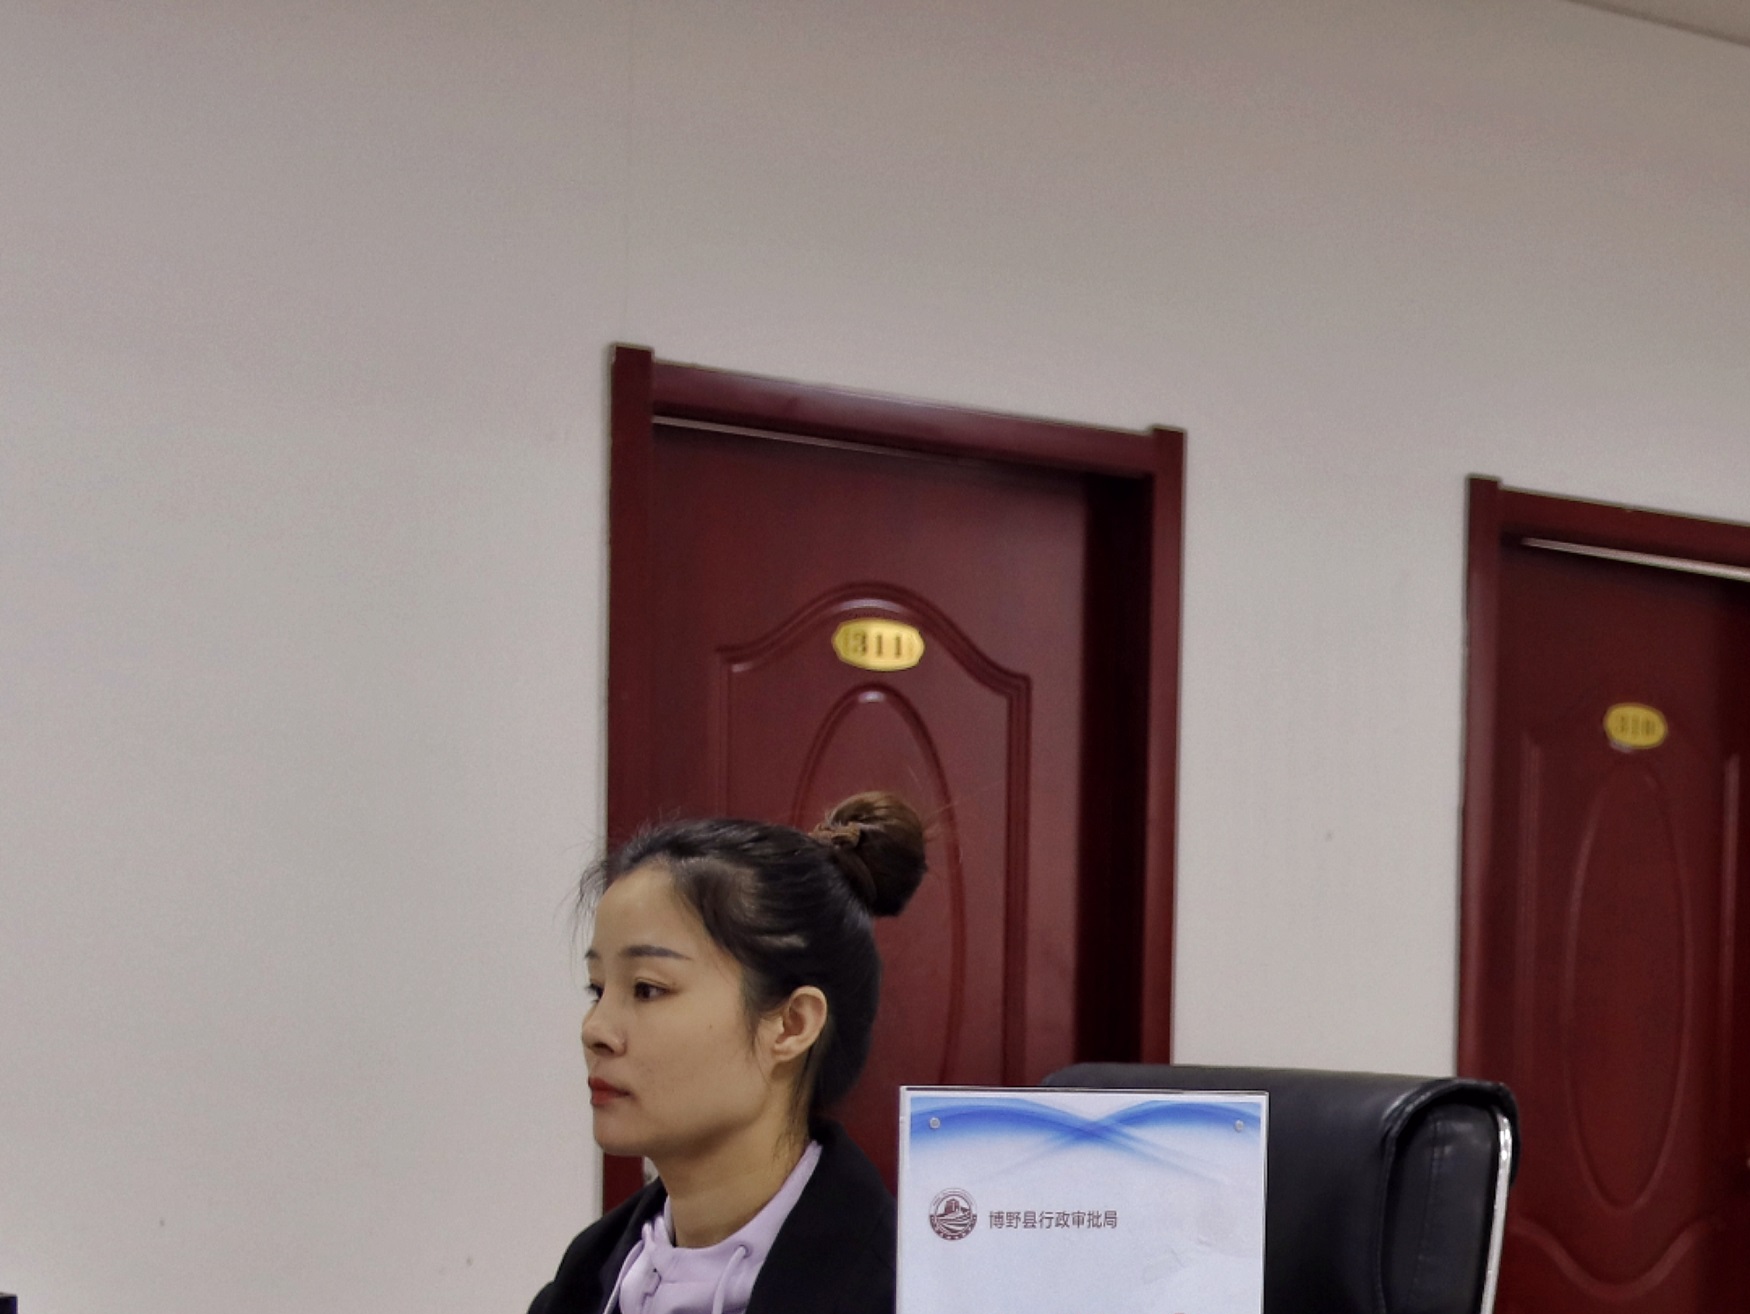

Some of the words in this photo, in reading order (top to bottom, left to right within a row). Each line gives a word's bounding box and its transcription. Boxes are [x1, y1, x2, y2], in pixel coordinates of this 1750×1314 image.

[988, 1210, 1118, 1229] 博野县行政审批局
